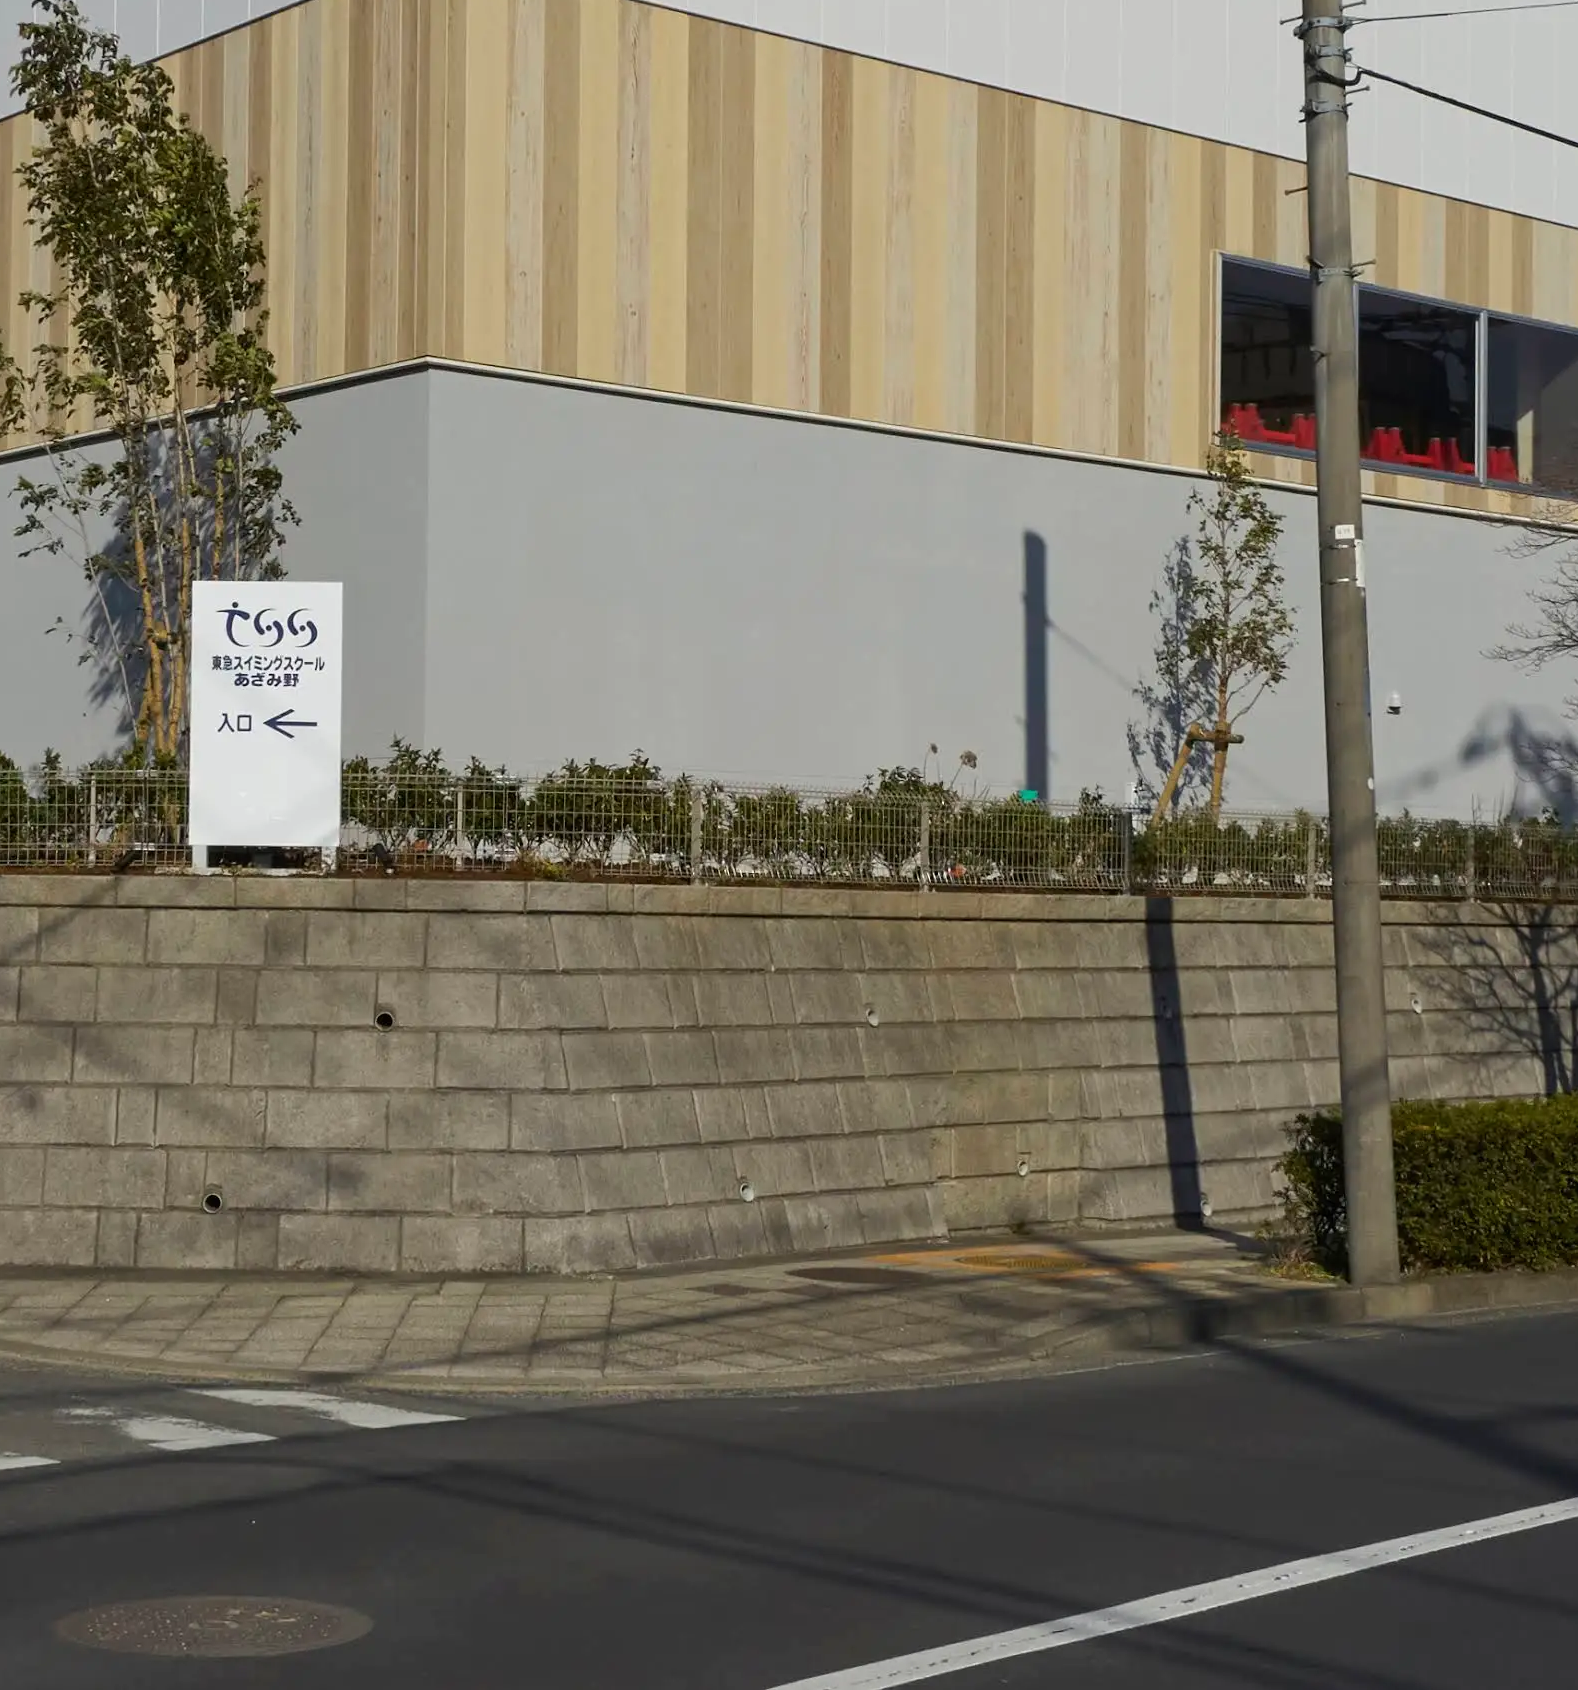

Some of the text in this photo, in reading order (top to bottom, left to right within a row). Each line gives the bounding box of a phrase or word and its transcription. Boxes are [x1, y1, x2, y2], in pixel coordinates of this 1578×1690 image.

[211, 655, 325, 672] 東急スイミングスクール
[233, 673, 299, 688] あざみ野
[217, 712, 252, 733] 入口
